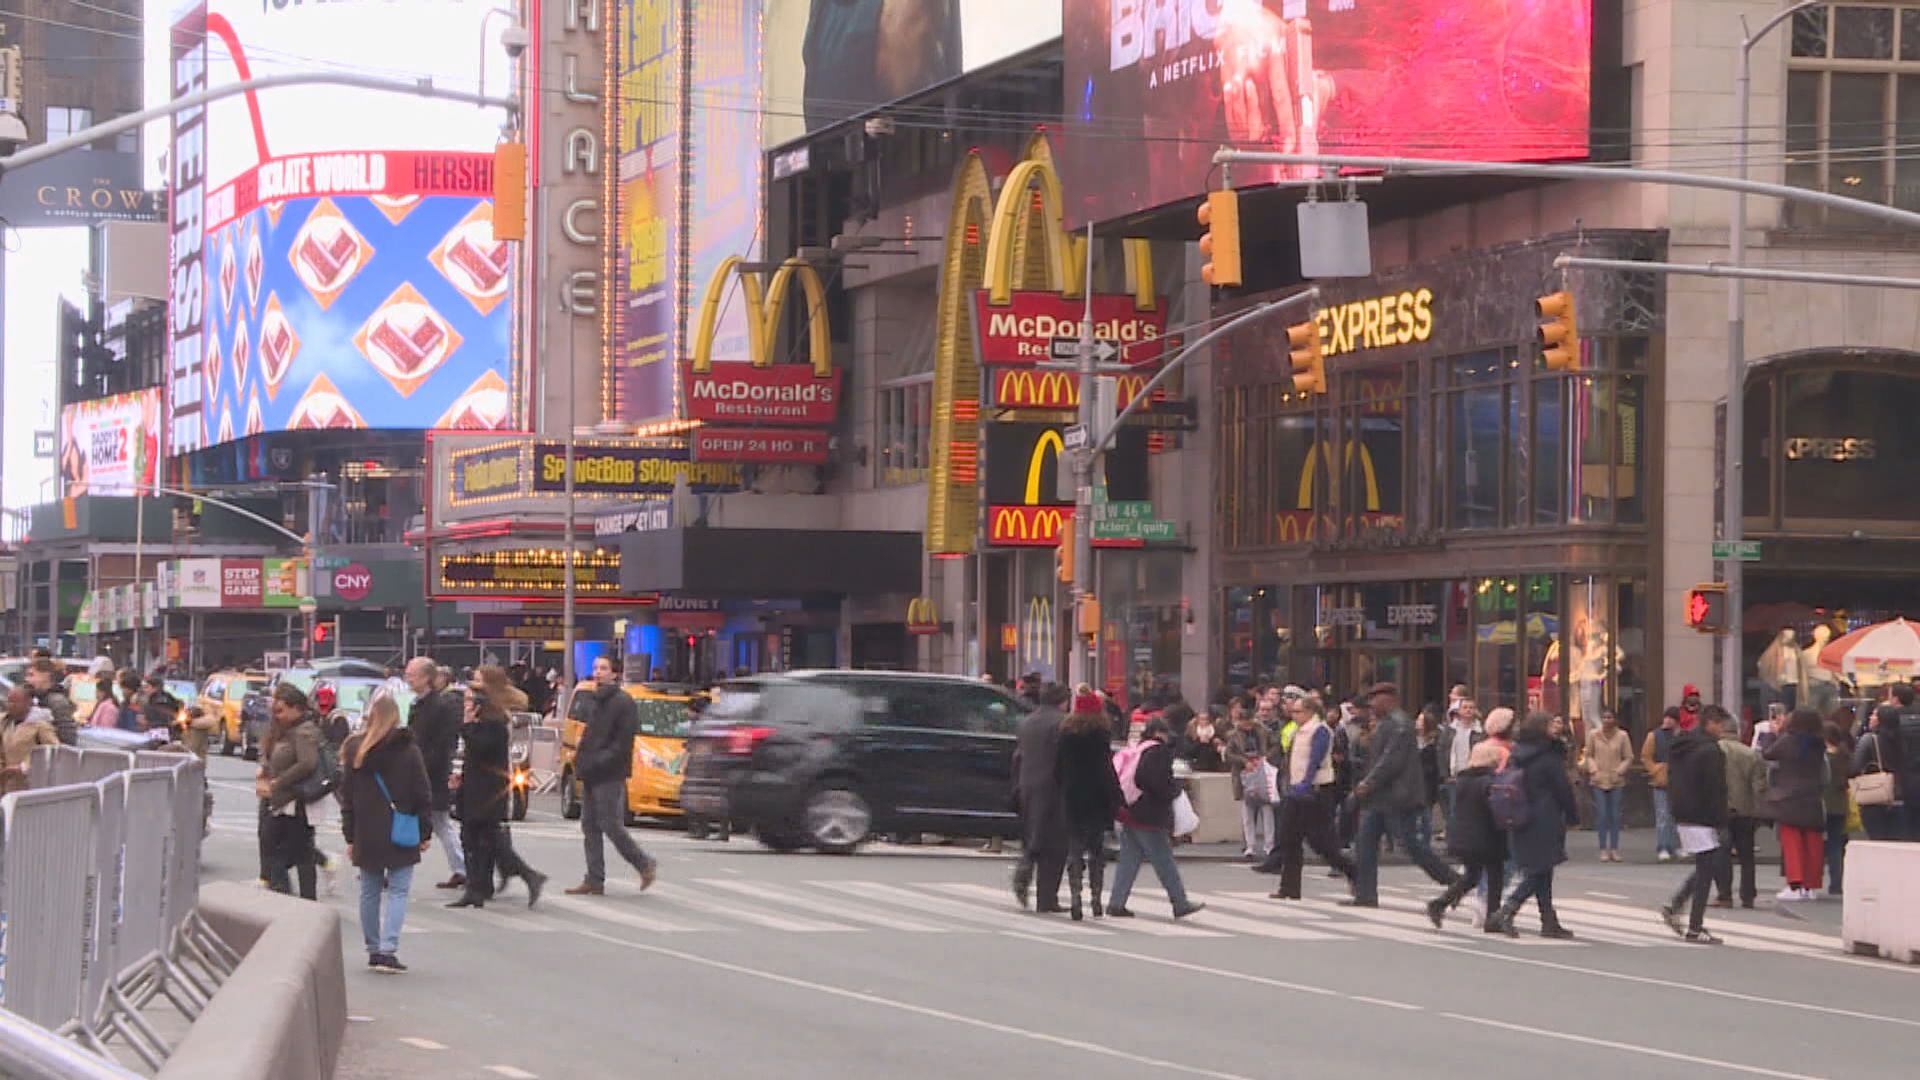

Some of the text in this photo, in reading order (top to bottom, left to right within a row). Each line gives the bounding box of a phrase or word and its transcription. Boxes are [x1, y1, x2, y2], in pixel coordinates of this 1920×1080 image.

[1149, 71, 1158, 88] A
[1163, 51, 1225, 84] NETFLIX
[312, 153, 386, 191] WORLD
[414, 156, 494, 193] HERSH
[1316, 288, 1432, 356] EXPRESS
[693, 380, 833, 403] McDonald's
[715, 402, 808, 416] Restaurant
[91, 427, 128, 465] HOME 2
[701, 439, 744, 451] OPEN
[749, 440, 768, 452] 24
[543, 454, 635, 484] SPNGEBOB
[224, 568, 259, 579] STEP
[335, 573, 371, 590] CNY
[224, 586, 259, 596] GAME
[659, 596, 721, 610] MONEY
